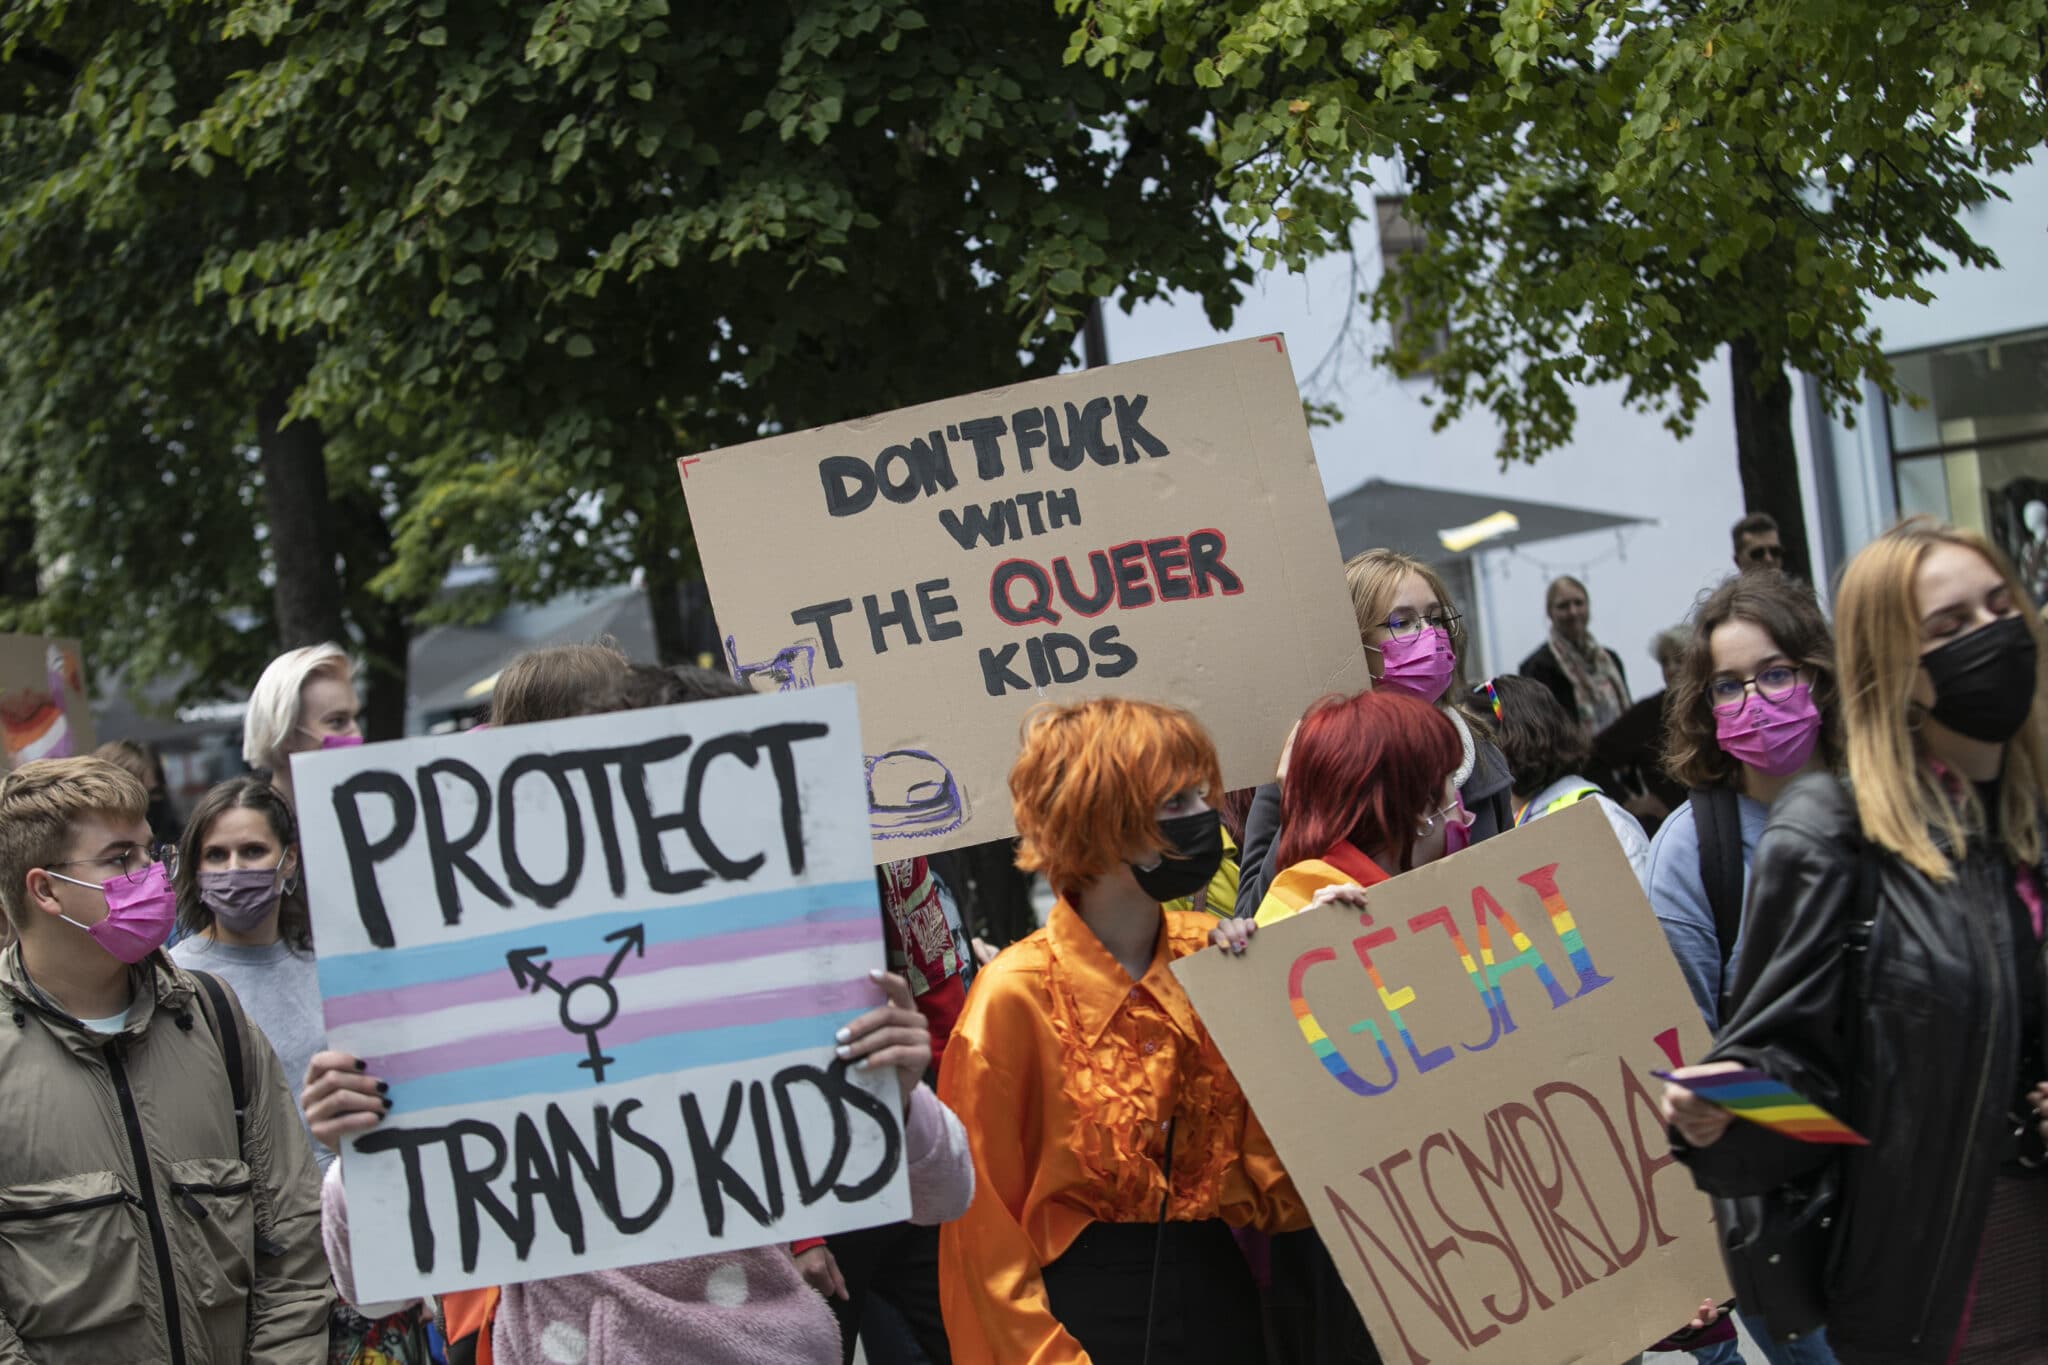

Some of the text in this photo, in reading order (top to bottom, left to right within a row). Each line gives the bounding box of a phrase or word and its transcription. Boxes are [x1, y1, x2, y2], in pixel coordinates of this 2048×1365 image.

[819, 394, 1170, 516] DON'T FUCK
[939, 488, 1081, 550] WITH
[792, 528, 1244, 669] THE QUEER
[979, 625, 1137, 697] KIDS
[332, 722, 829, 948] PROTECT
[1287, 862, 1614, 1096] GĖJAI
[353, 1058, 902, 1274] TRANS KIDS
